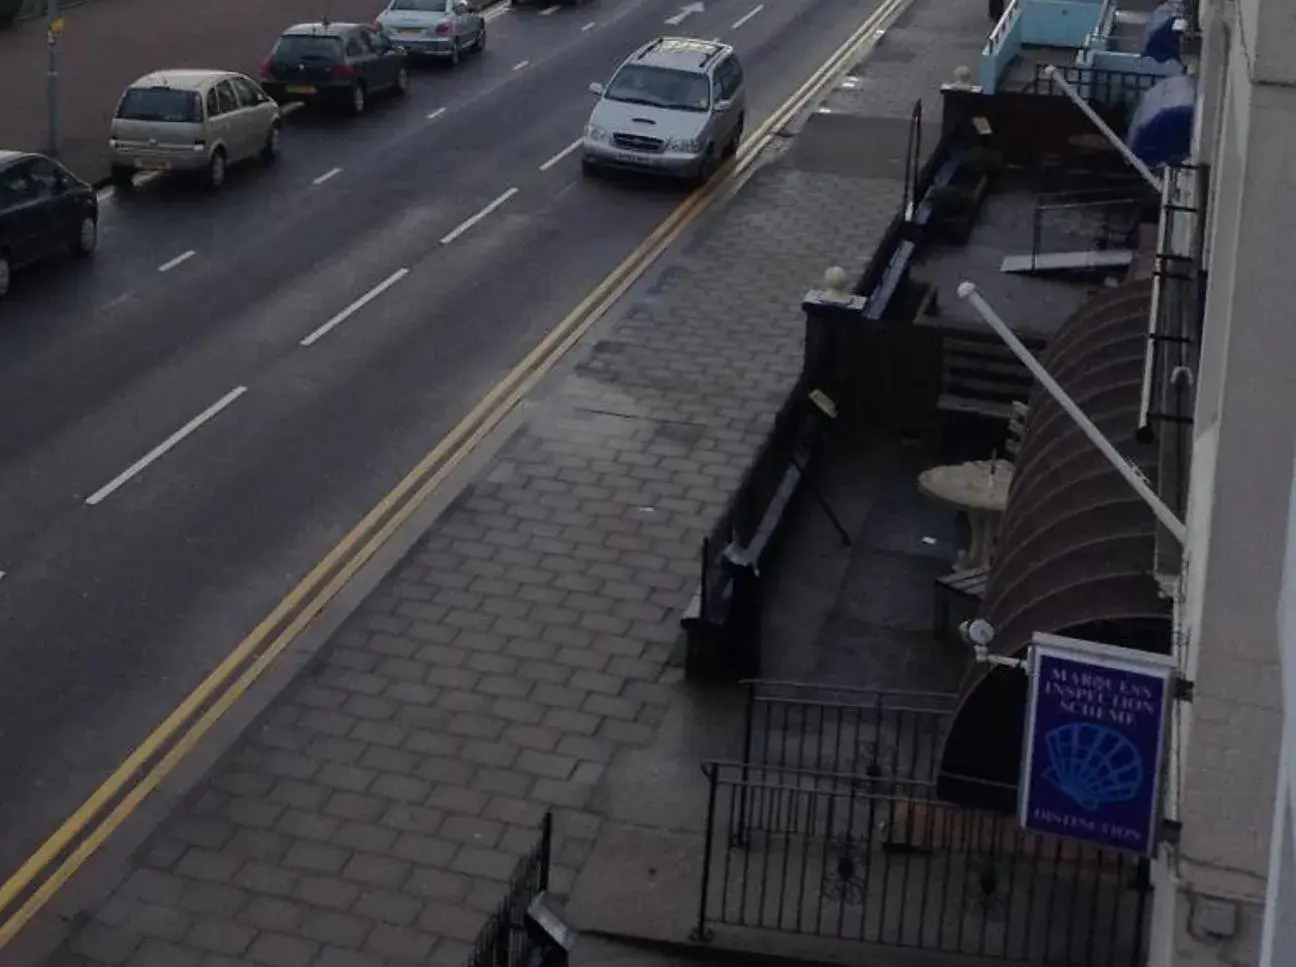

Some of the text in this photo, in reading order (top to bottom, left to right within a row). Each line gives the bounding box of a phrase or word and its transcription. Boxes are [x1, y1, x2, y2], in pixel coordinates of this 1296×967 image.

[1045, 680, 1154, 715] INSPECTION
[1051, 667, 1153, 700] MARQUESS
[1059, 699, 1135, 725] SCHEME
